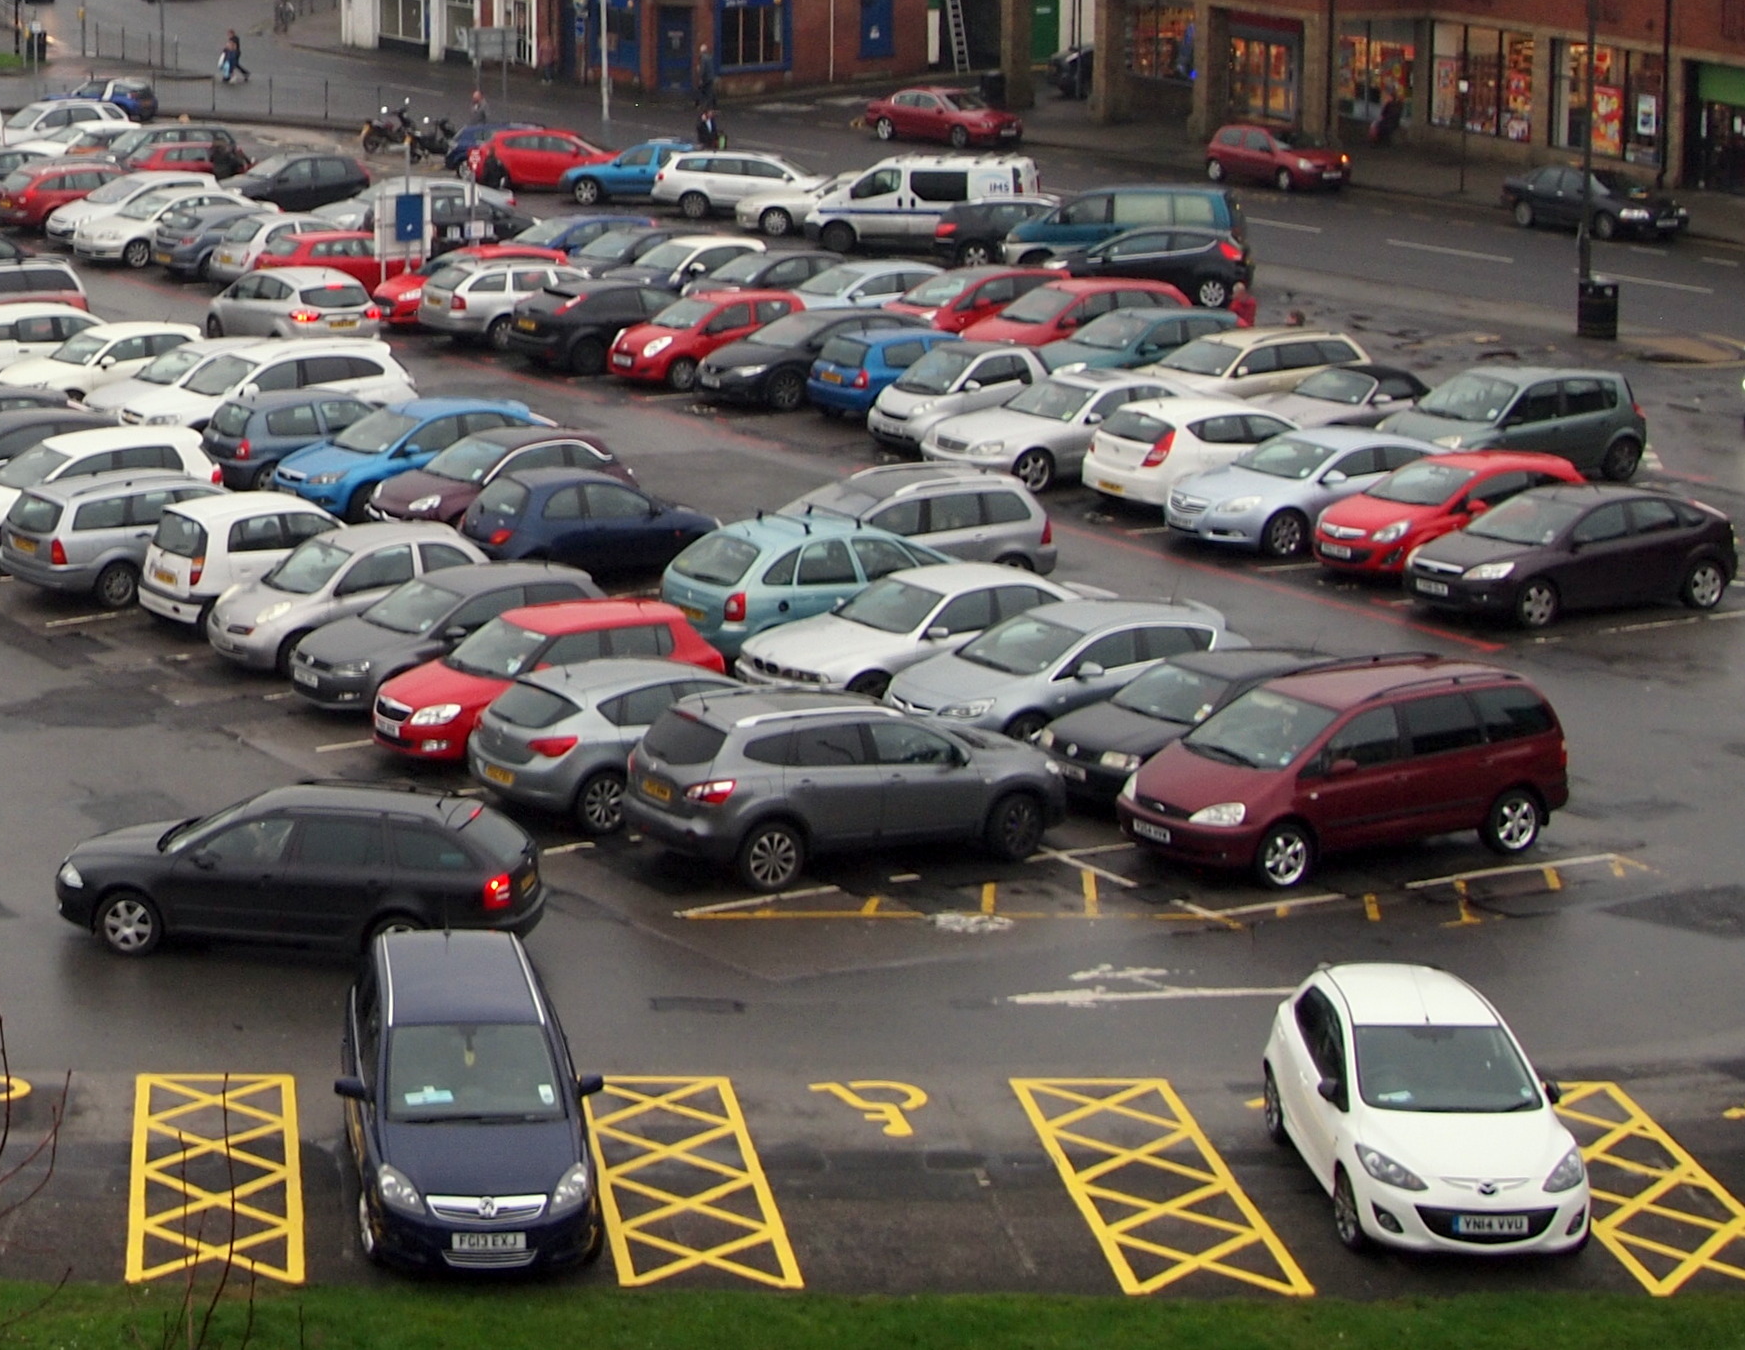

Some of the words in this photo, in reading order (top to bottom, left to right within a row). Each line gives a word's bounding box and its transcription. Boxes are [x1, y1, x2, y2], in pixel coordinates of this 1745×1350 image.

[989, 181, 1010, 193] IMS
[1464, 1217, 1493, 1230] YN14
[1497, 1217, 1523, 1230] VVU
[459, 1233, 488, 1248] FC13
[491, 1233, 518, 1247] EXJ
